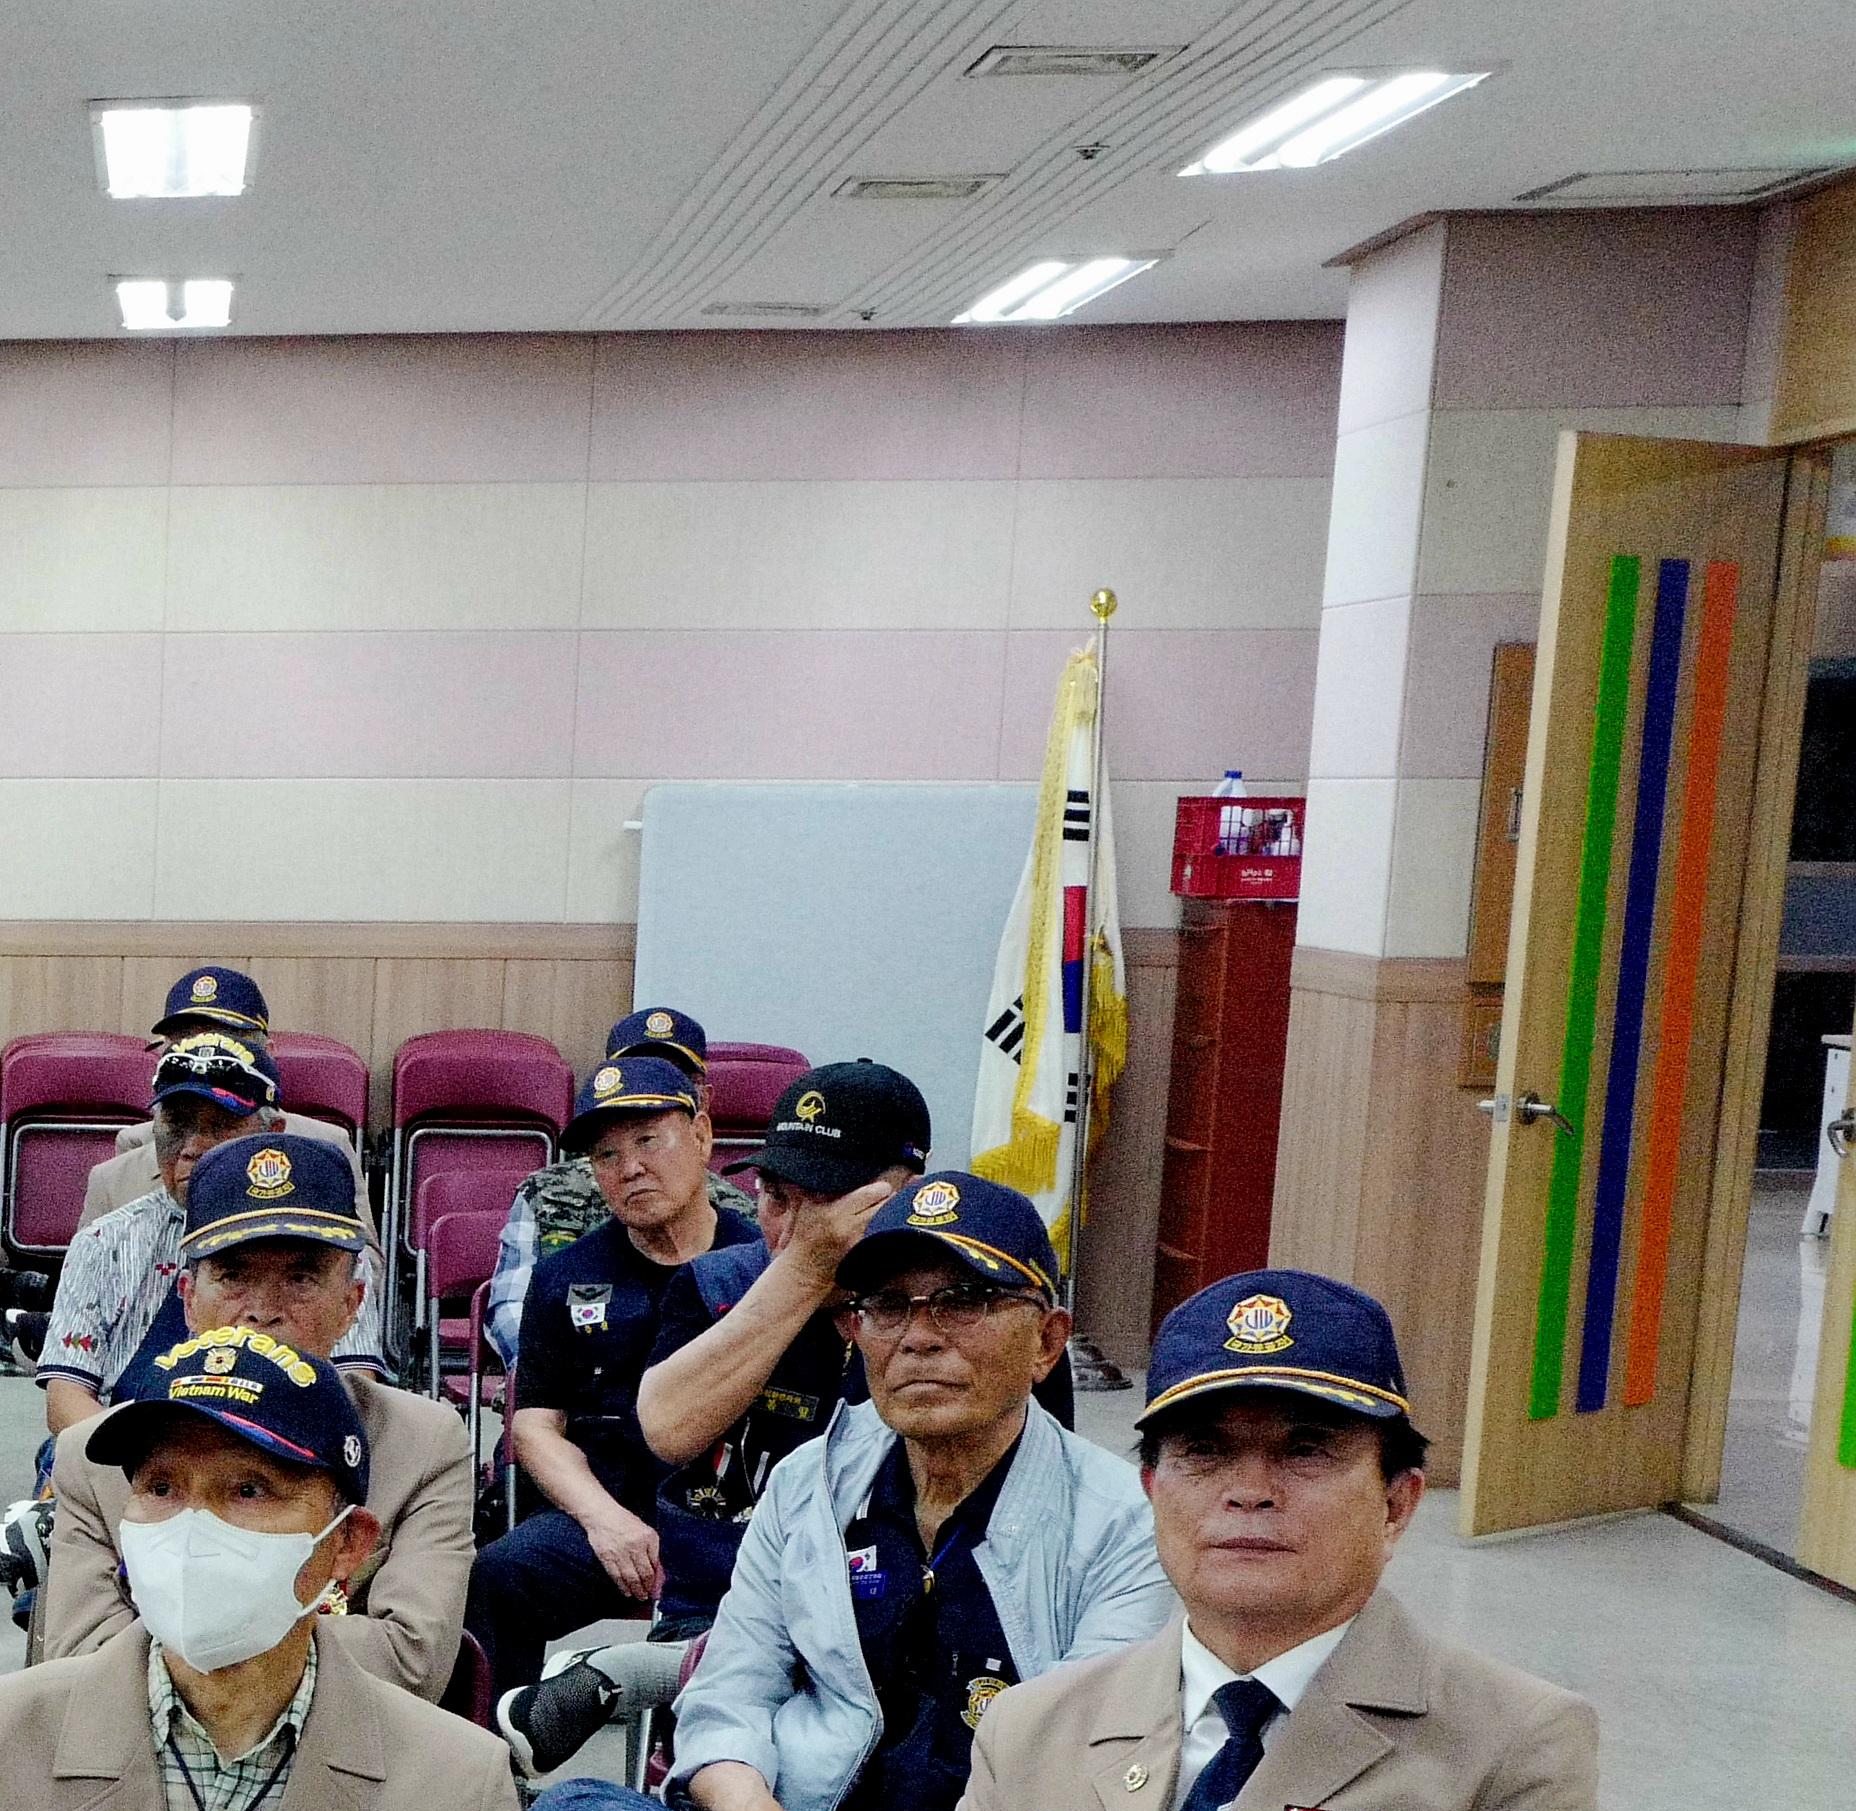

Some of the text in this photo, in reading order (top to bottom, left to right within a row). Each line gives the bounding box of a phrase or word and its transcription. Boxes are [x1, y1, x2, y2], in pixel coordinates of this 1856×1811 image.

[815, 1125, 841, 1138] CLUB
[154, 1326, 317, 1387] Veterans
[169, 1384, 261, 1403] Vietnam War
